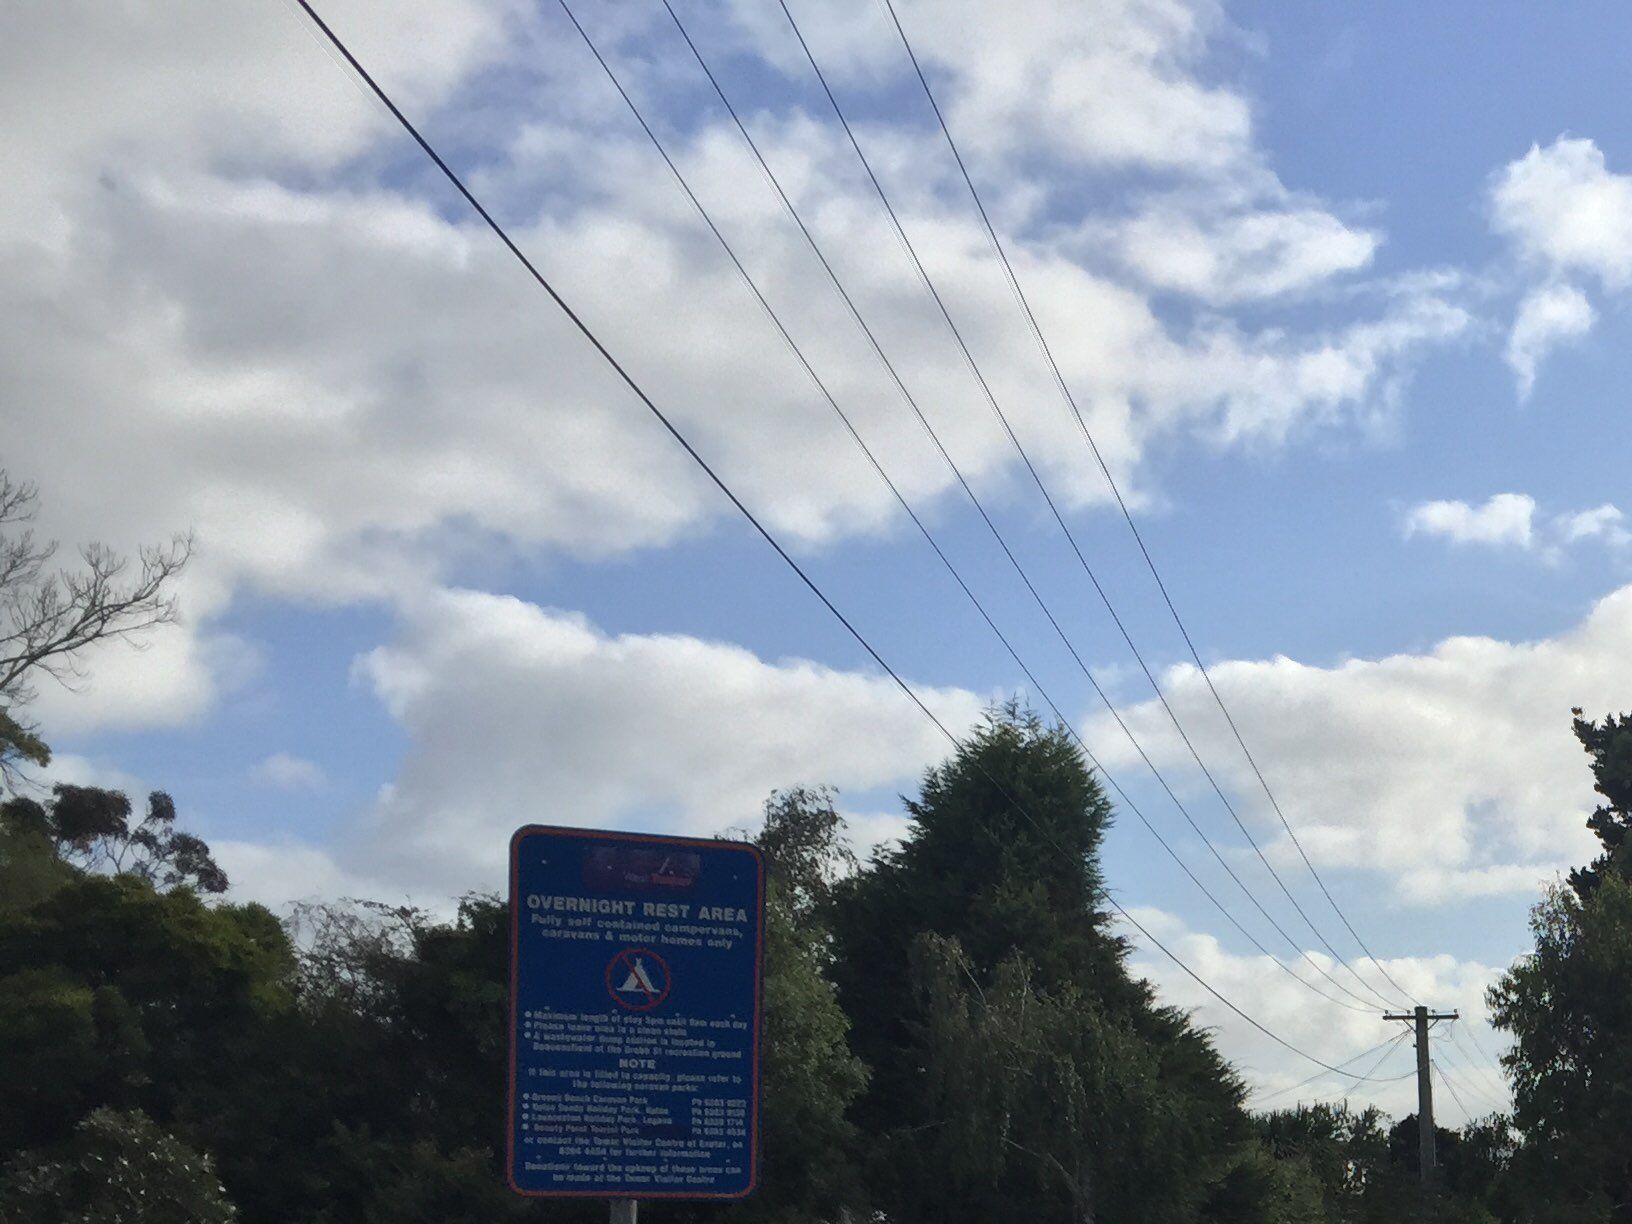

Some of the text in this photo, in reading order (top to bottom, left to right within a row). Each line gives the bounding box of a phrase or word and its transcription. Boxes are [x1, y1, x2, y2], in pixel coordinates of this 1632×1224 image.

[527, 895, 748, 922] OVERNIGHT REST AREA
[531, 914, 562, 926] Fully
[568, 917, 592, 927] self
[597, 920, 659, 931] contained
[542, 929, 733, 950] caravans & motor homes only
[619, 1058, 656, 1069] NOTE
